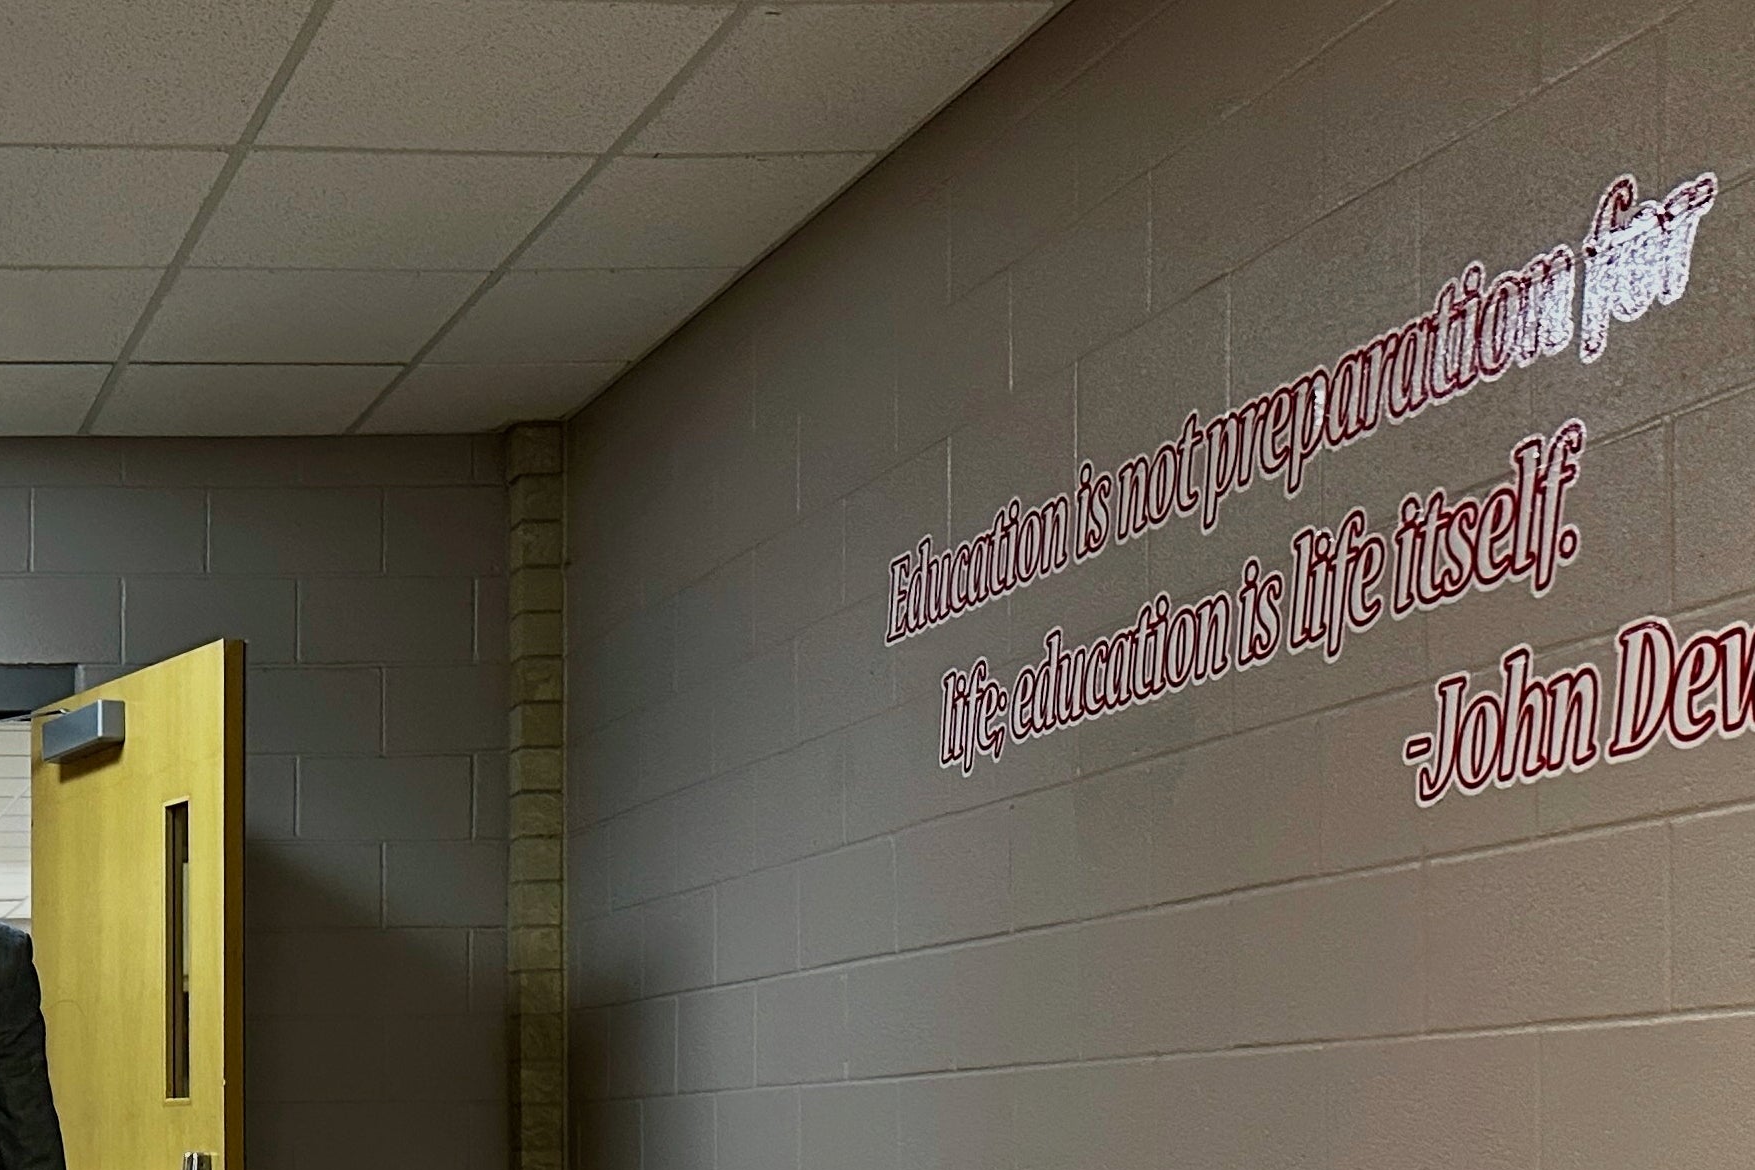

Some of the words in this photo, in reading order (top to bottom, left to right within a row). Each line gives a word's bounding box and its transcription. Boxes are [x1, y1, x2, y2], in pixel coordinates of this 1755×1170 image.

[886, 497, 1069, 646] Education
[1074, 462, 1112, 562] is
[1116, 409, 1205, 544] not
[1201, 243, 1576, 532] preparation
[940, 656, 1007, 778] life;
[1010, 590, 1229, 742] education
[1238, 559, 1284, 671] is
[1289, 505, 1386, 664] life
[1391, 416, 1586, 618] itself.
[1404, 644, 1601, 807] -John
